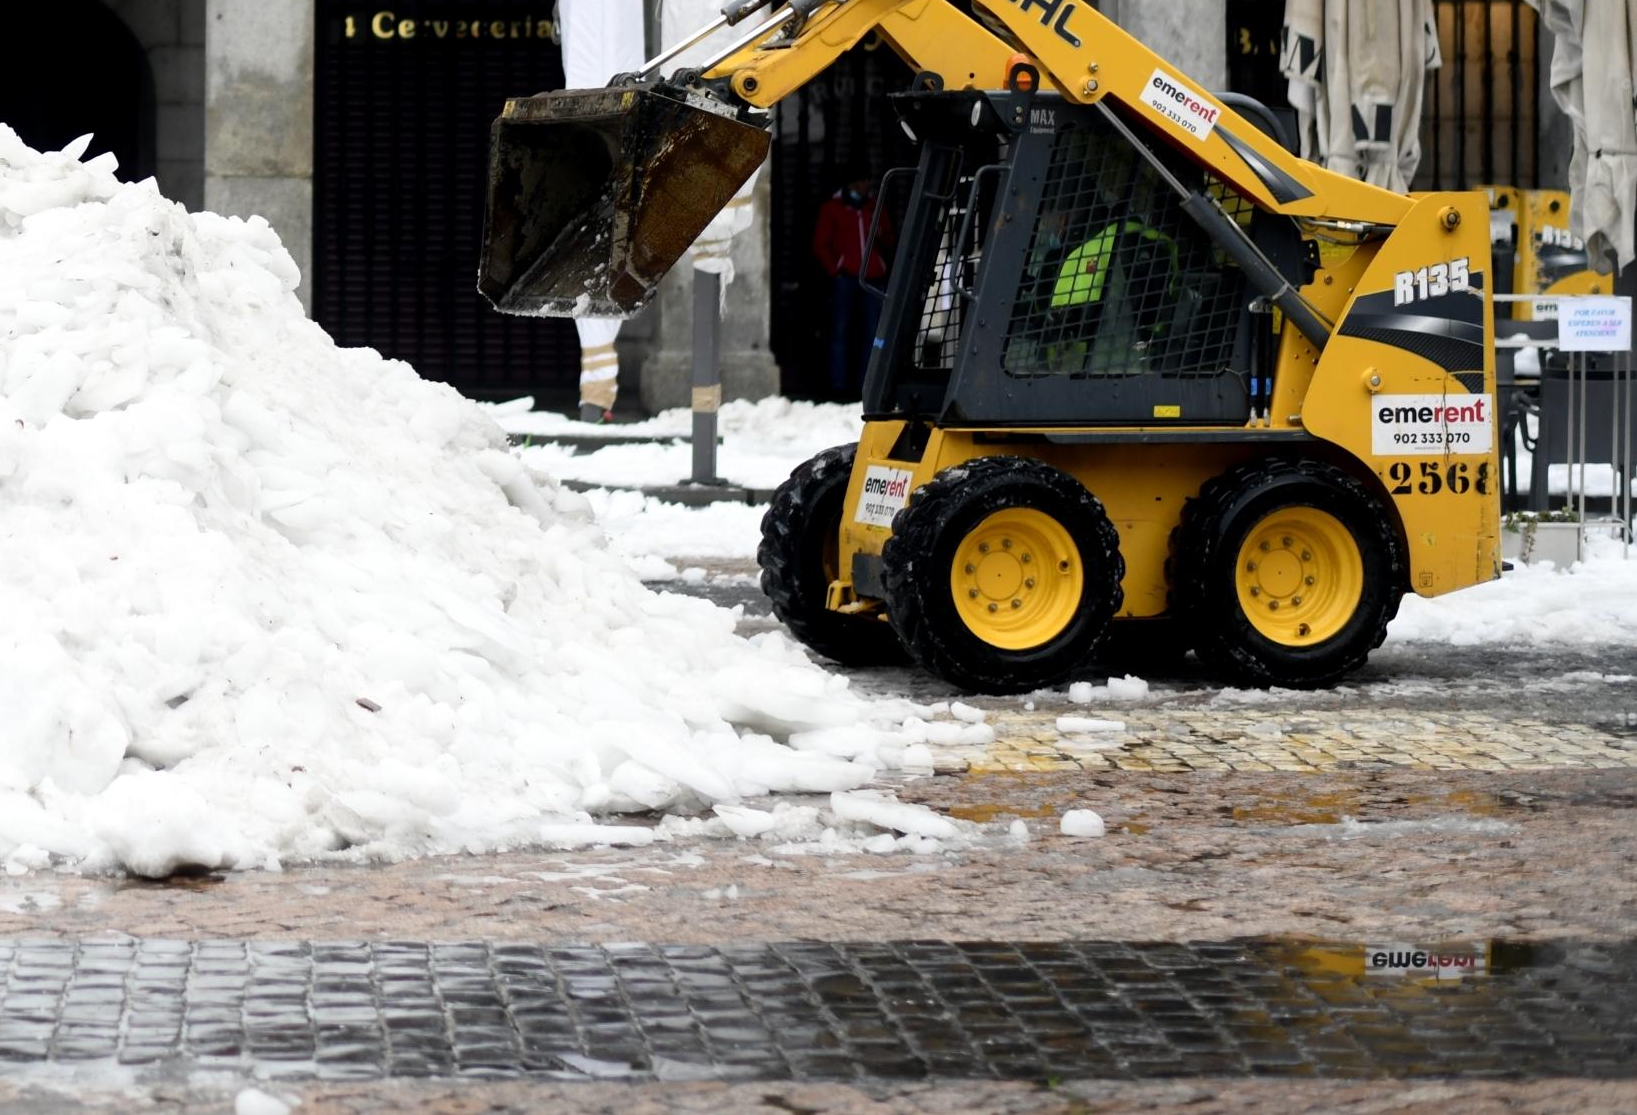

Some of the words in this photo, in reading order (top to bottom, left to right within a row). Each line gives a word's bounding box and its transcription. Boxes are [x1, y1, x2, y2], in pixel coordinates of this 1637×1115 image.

[1152, 76, 1218, 124] emerent
[1030, 109, 1055, 126] MAX
[1152, 100, 1167, 114] 902
[1167, 110, 1182, 123] 333
[1181, 119, 1197, 134] 070
[1395, 257, 1470, 307] R135
[1378, 398, 1485, 424] emerent
[1393, 433, 1418, 444] 902
[1420, 433, 1443, 444] 333
[1446, 432, 1470, 443] 070
[865, 476, 908, 498] emerent
